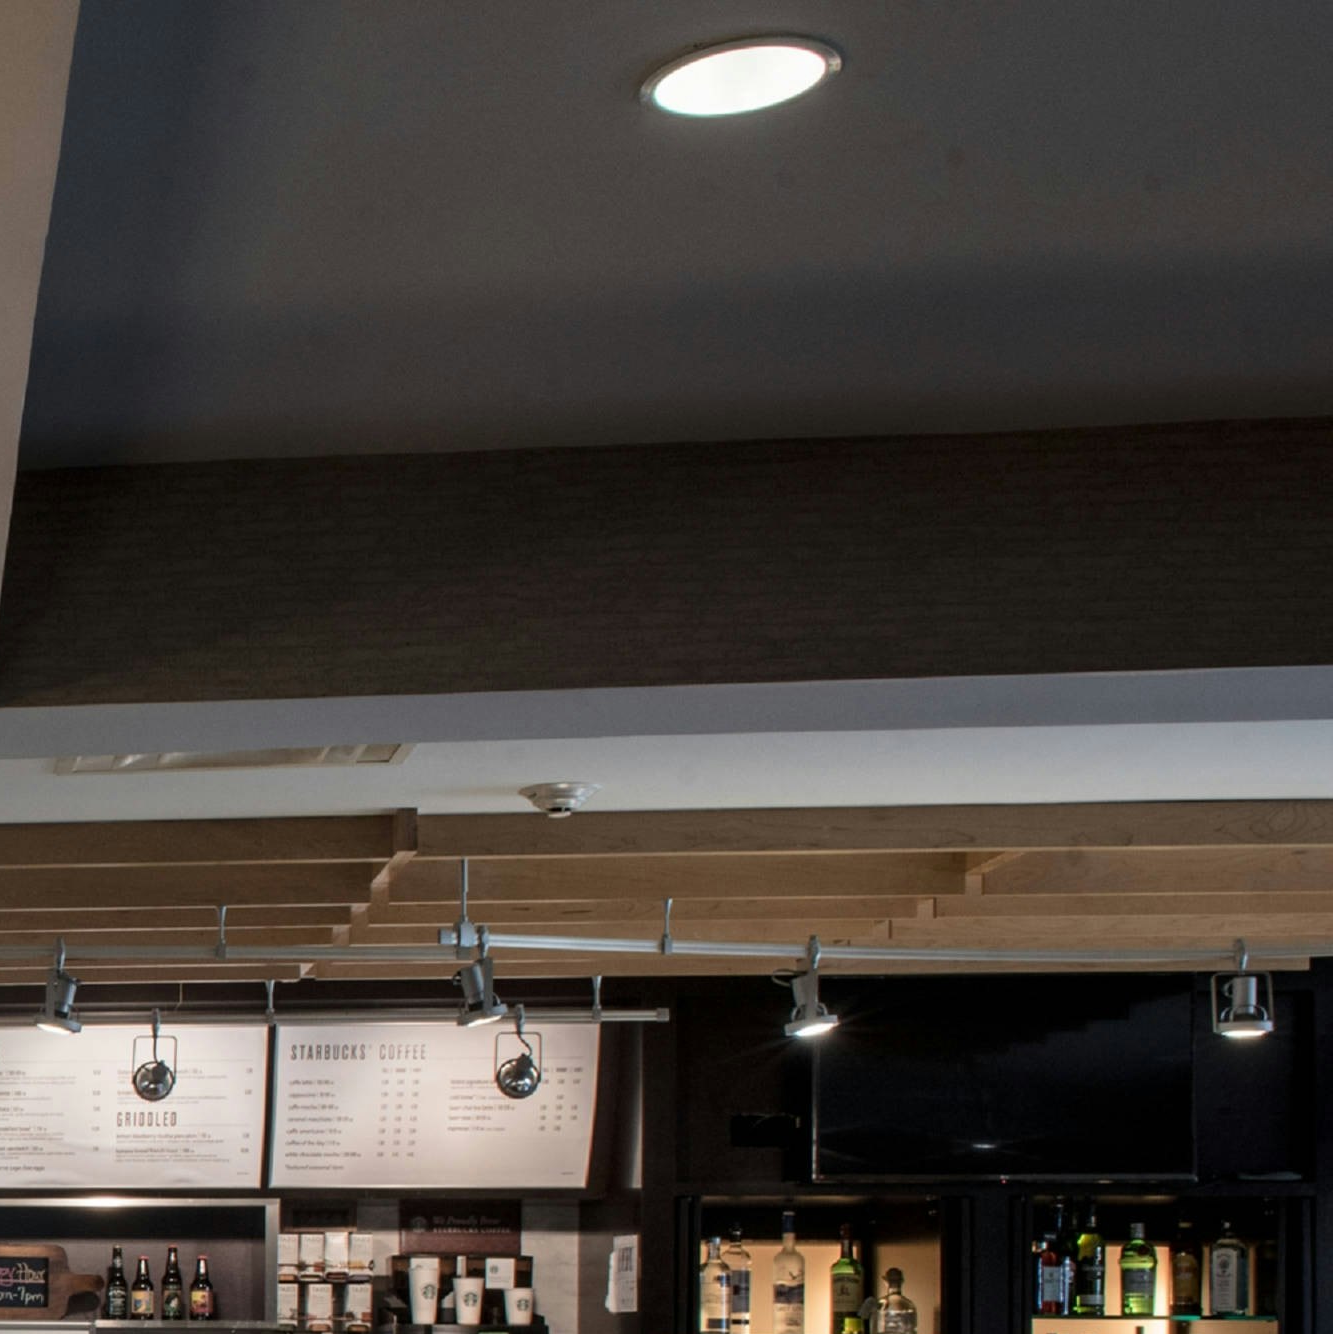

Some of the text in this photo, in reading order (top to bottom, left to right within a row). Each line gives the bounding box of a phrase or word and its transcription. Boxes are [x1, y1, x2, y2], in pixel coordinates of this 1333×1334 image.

[290, 1043, 426, 1061] STARBUCKS COFFEE
[116, 1111, 177, 1127] GRIDDLED
[15, 1262, 46, 1281] Hour
